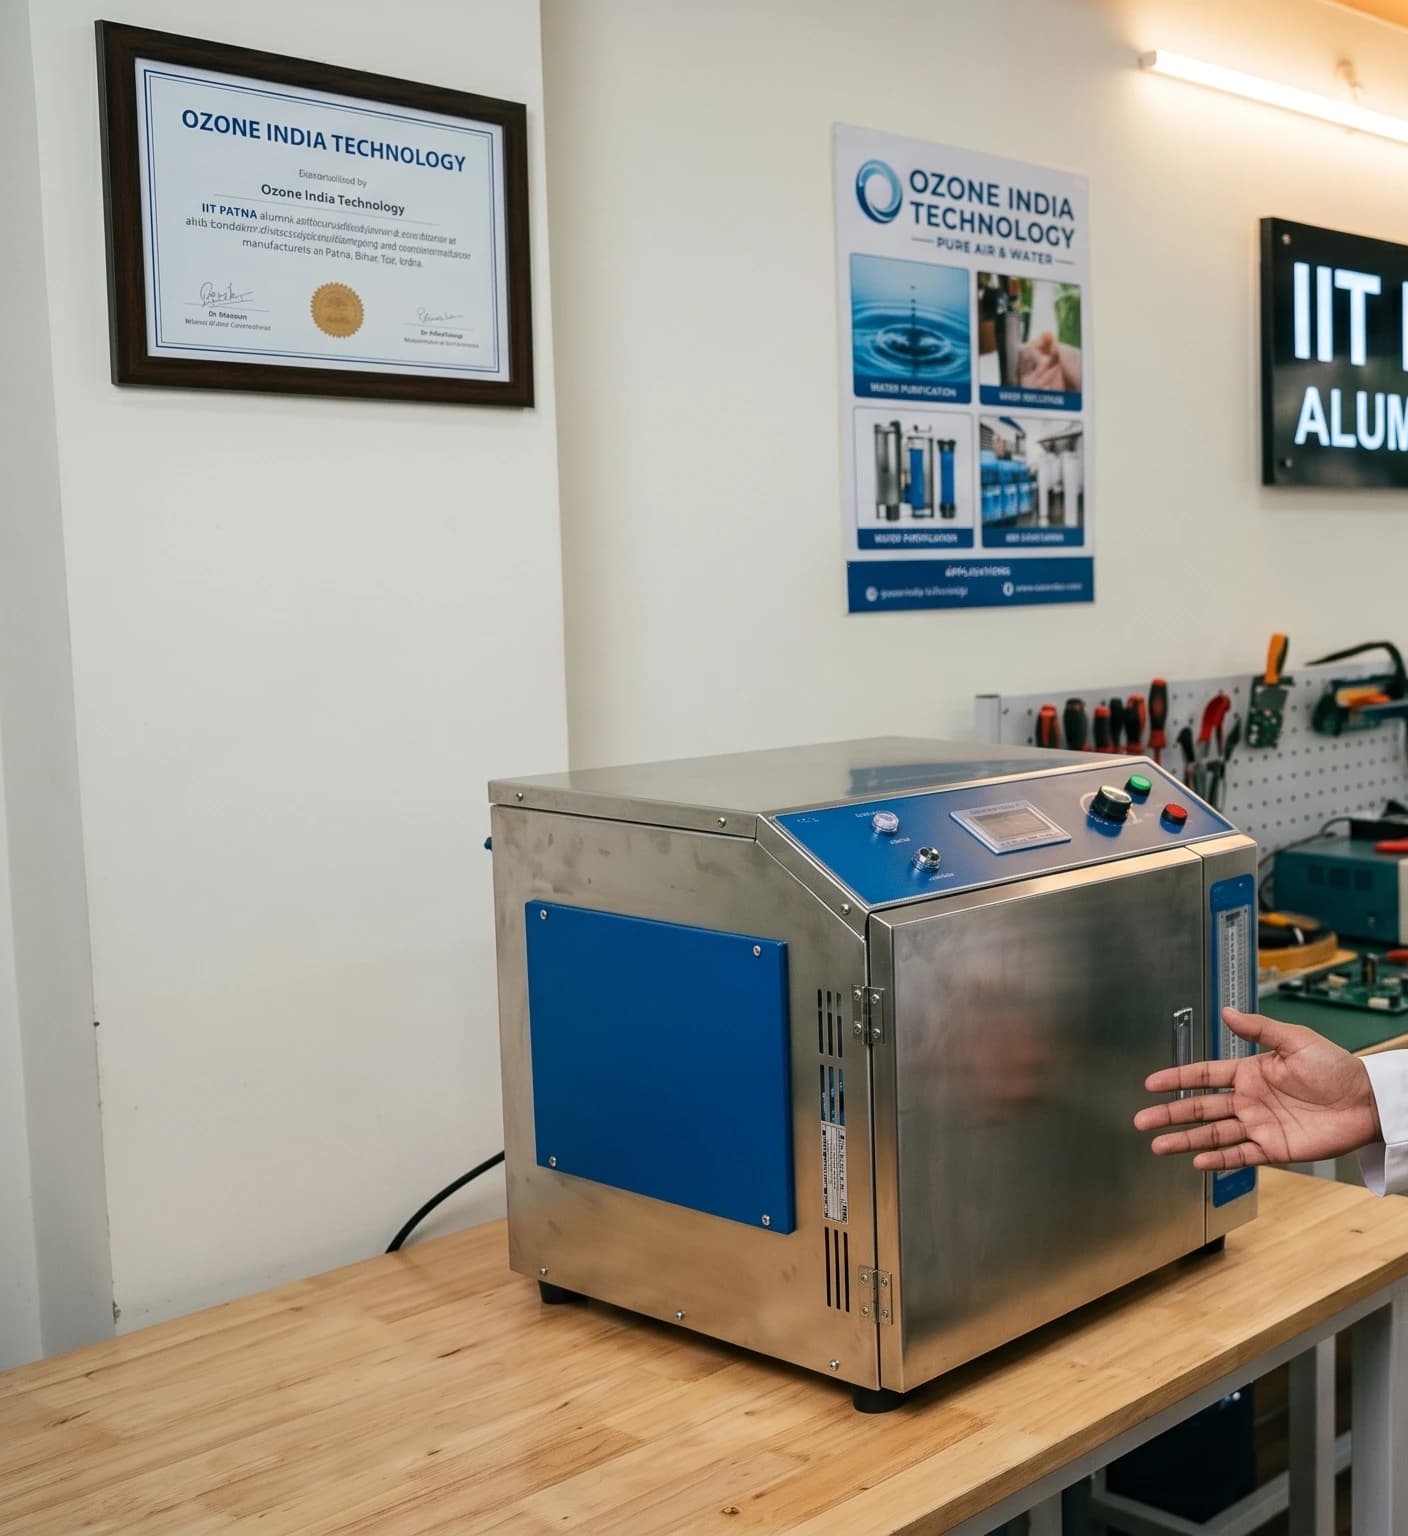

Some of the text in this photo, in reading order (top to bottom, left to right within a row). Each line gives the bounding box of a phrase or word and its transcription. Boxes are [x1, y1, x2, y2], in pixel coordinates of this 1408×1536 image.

[182, 109, 466, 172] OZONE INDIA TECHNOLOGY
[202, 203, 217, 213] IIT
[220, 205, 258, 219] PATNA
[261, 184, 405, 216] Ozone India Technology
[909, 169, 1074, 221] OZONE INDIA
[909, 201, 1075, 249] TECHNOLOGY
[937, 237, 1053, 264] PURE AIR & WATER
[1294, 262, 1381, 366] IIT
[901, 383, 957, 398] PURIFICATION
